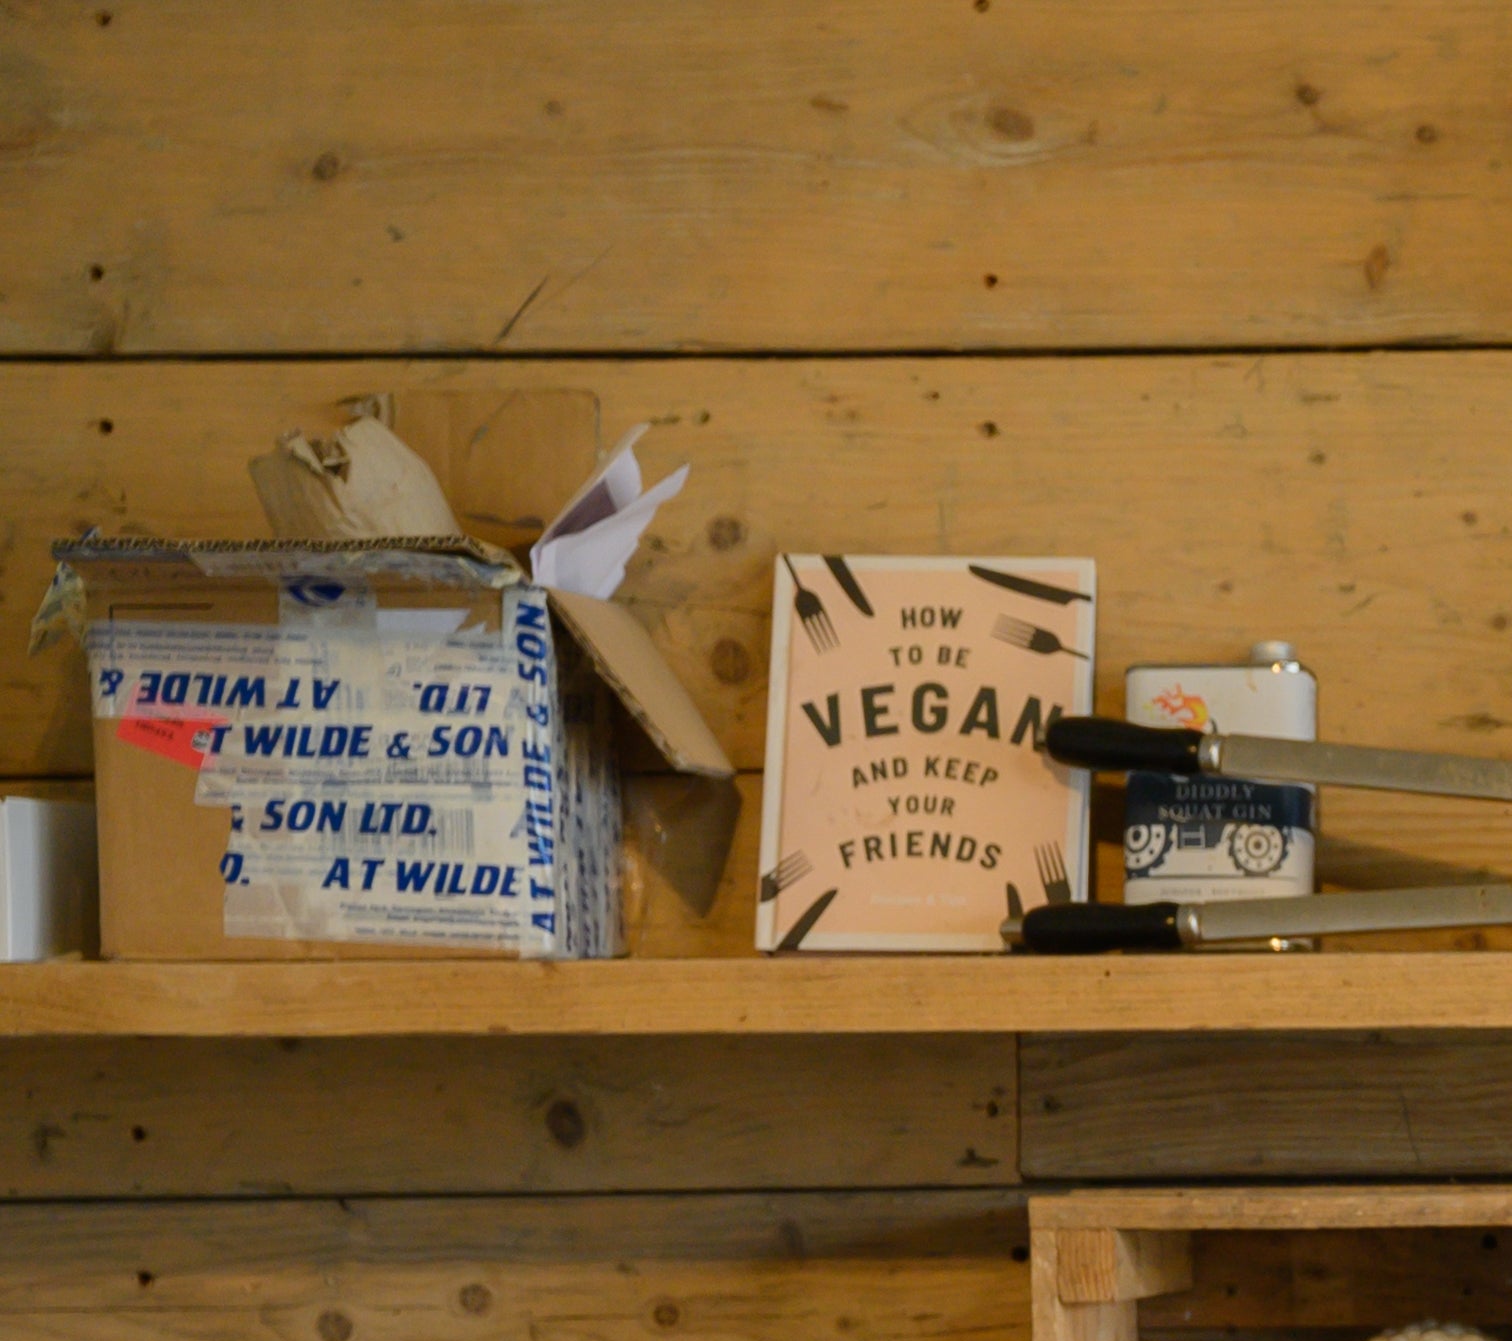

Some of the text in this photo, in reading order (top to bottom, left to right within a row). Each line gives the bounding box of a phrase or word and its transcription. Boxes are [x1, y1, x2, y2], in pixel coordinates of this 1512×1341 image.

[901, 605, 964, 631] HOW
[889, 644, 972, 670] TO BE
[138, 673, 266, 707] WILDE
[277, 678, 304, 708] T
[312, 678, 341, 711] A
[413, 683, 492, 713] LTD.
[801, 681, 1065, 753] VEGAN
[210, 725, 237, 755] T
[244, 726, 373, 756] WILDE
[387, 730, 412, 757] &
[428, 726, 511, 757] SON
[517, 601, 556, 935] A T WILDE & SON
[851, 755, 1000, 790] AND KEEP
[887, 794, 956, 818] YOUR
[1175, 783, 1255, 801] DIDDLY
[260, 801, 345, 832] SON
[360, 802, 438, 836] LTD.
[1158, 803, 1272, 822] SQUAT GIN
[838, 830, 1003, 870] FRIENDS
[324, 857, 352, 889] A
[361, 859, 386, 889] T
[396, 861, 521, 897] WILDE
